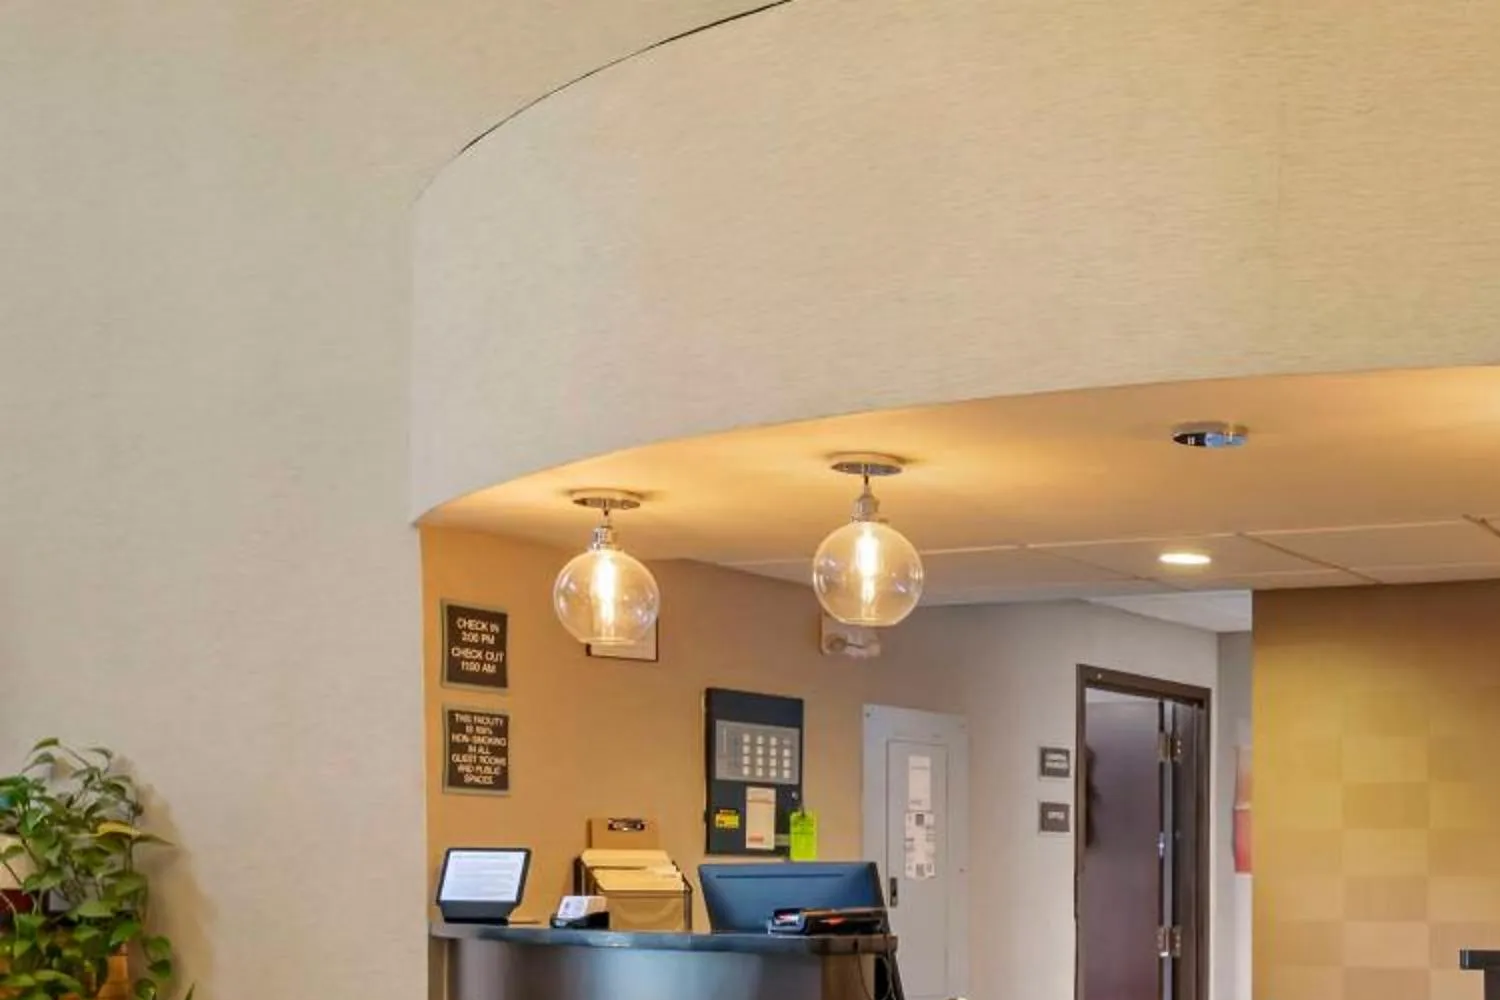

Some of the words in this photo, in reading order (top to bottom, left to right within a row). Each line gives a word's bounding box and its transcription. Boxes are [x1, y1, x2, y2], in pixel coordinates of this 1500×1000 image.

[456, 617, 488, 631] CHECK
[490, 624, 499, 633] IN
[481, 634, 495, 644] PM
[451, 647, 483, 660] CHECK
[485, 651, 504, 663] OUT
[482, 664, 496, 673] AM
